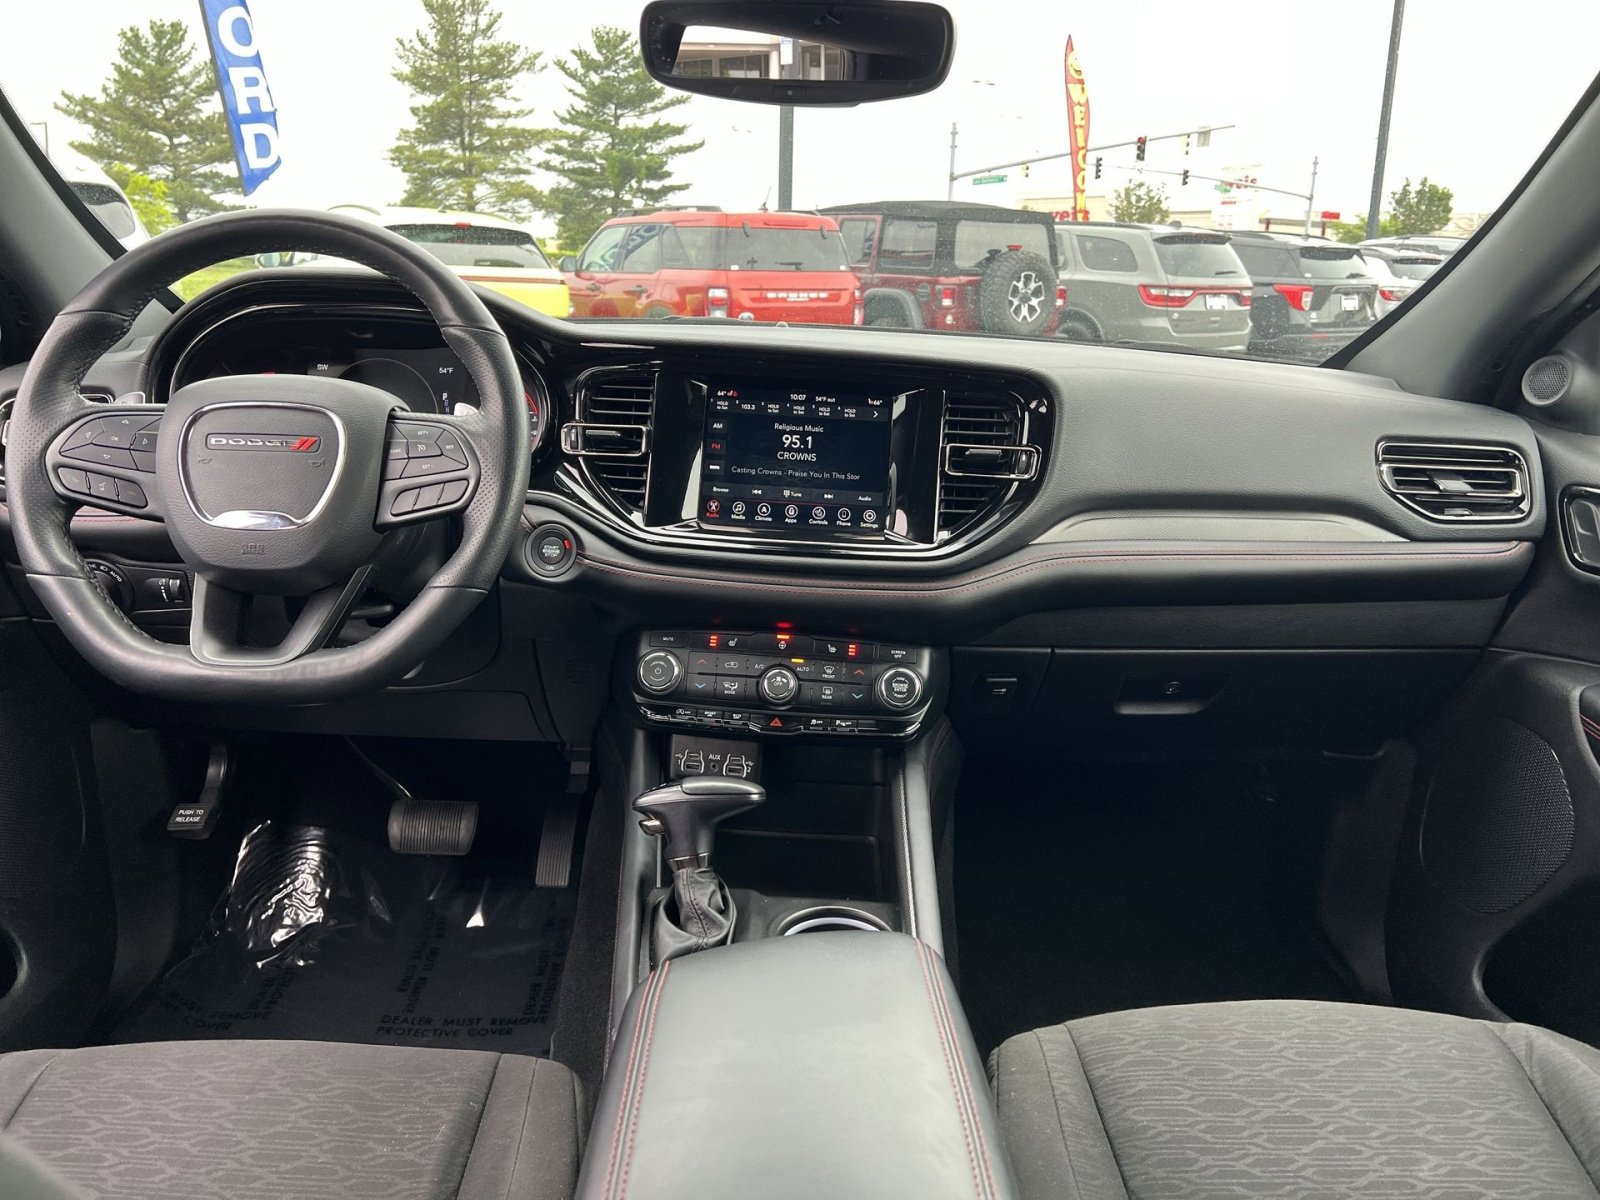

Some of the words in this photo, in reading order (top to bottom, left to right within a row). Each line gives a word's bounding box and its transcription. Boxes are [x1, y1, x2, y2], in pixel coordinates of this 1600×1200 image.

[774, 422, 804, 432] Religious
[804, 425, 824, 433] Music
[782, 434, 813, 449] 95.1
[777, 451, 817, 462] CROWNS
[731, 466, 756, 475] Casting
[757, 468, 782, 476] Crowns
[832, 472, 845, 480] This
[110, 571, 123, 582] AUTO
[441, 1017, 482, 1027] MUST
[467, 1027, 513, 1037] COVER
